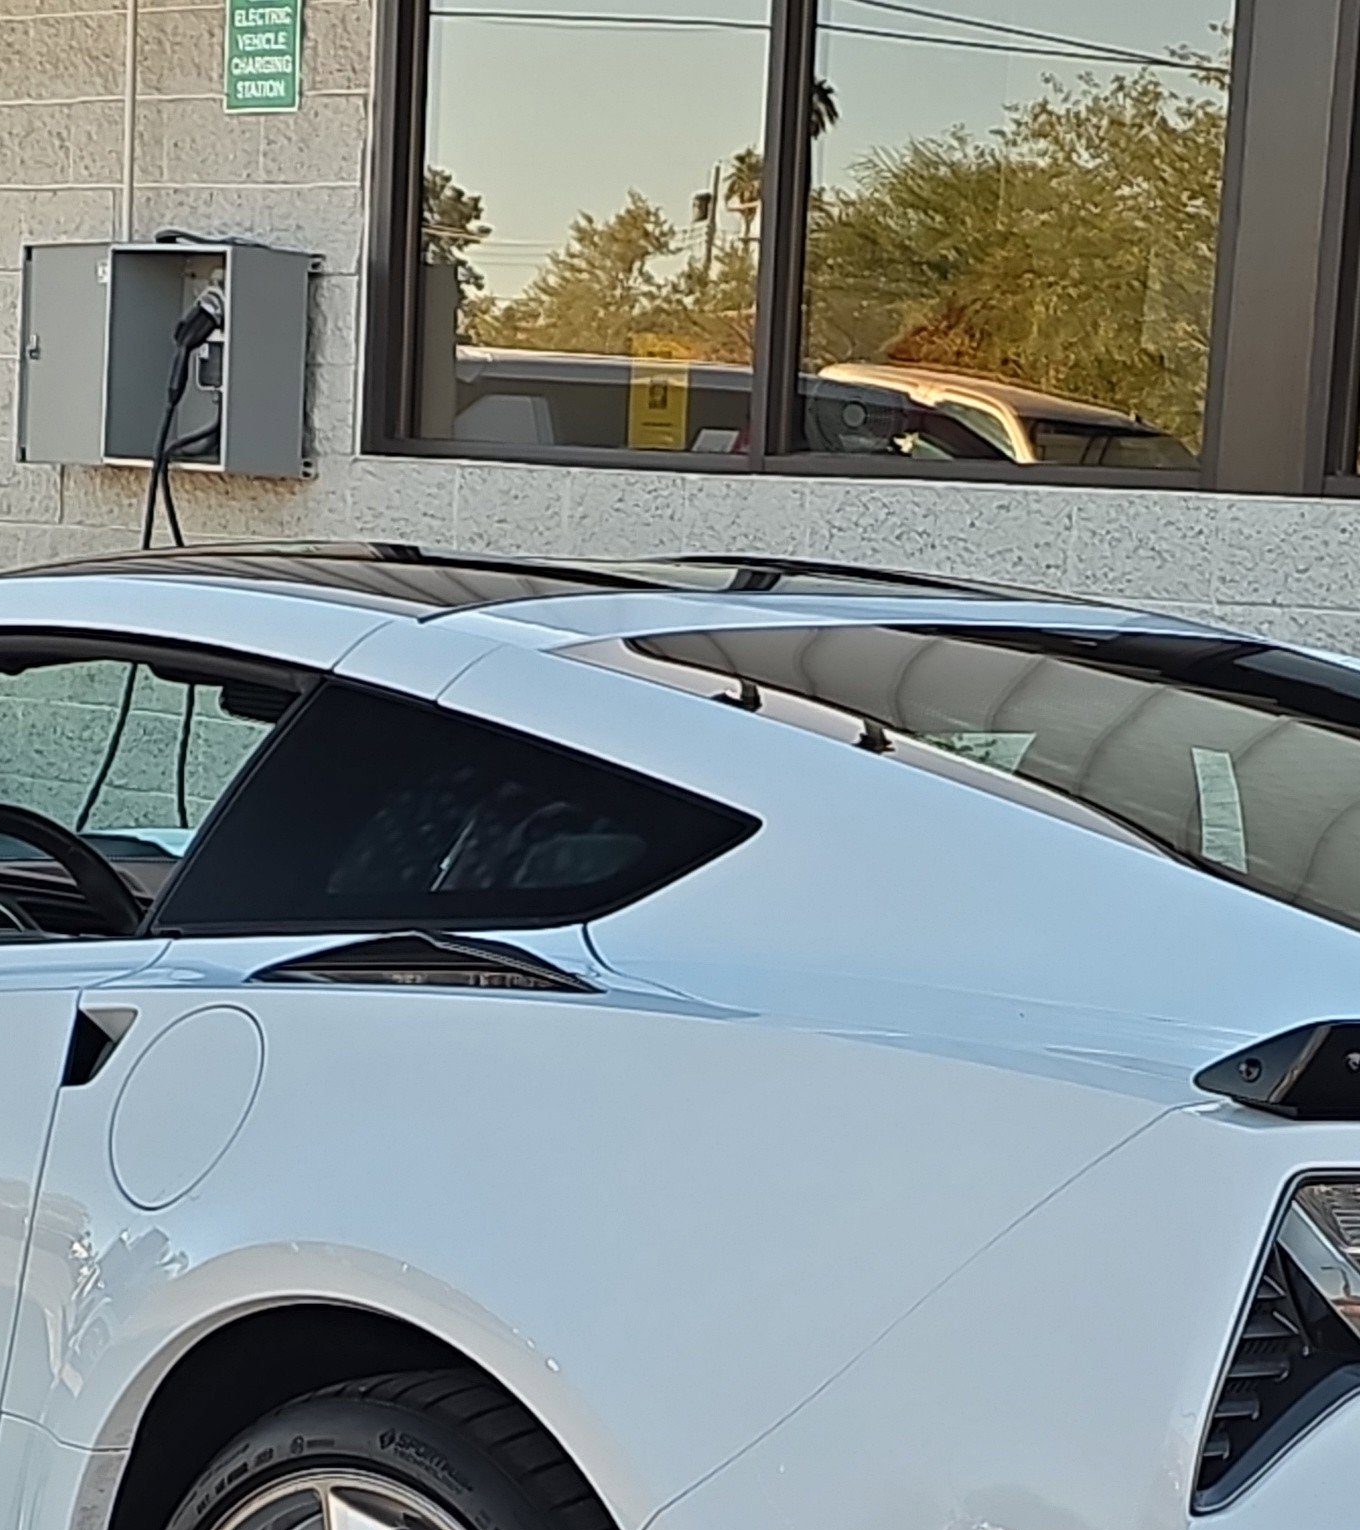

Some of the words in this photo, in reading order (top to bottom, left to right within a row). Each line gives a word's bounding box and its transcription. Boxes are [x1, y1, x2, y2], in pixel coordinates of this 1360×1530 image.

[234, 6, 292, 27] ELECTRIC
[236, 31, 288, 51] VEHICLE
[230, 54, 293, 76] CHARGING
[235, 79, 286, 99] STATION
